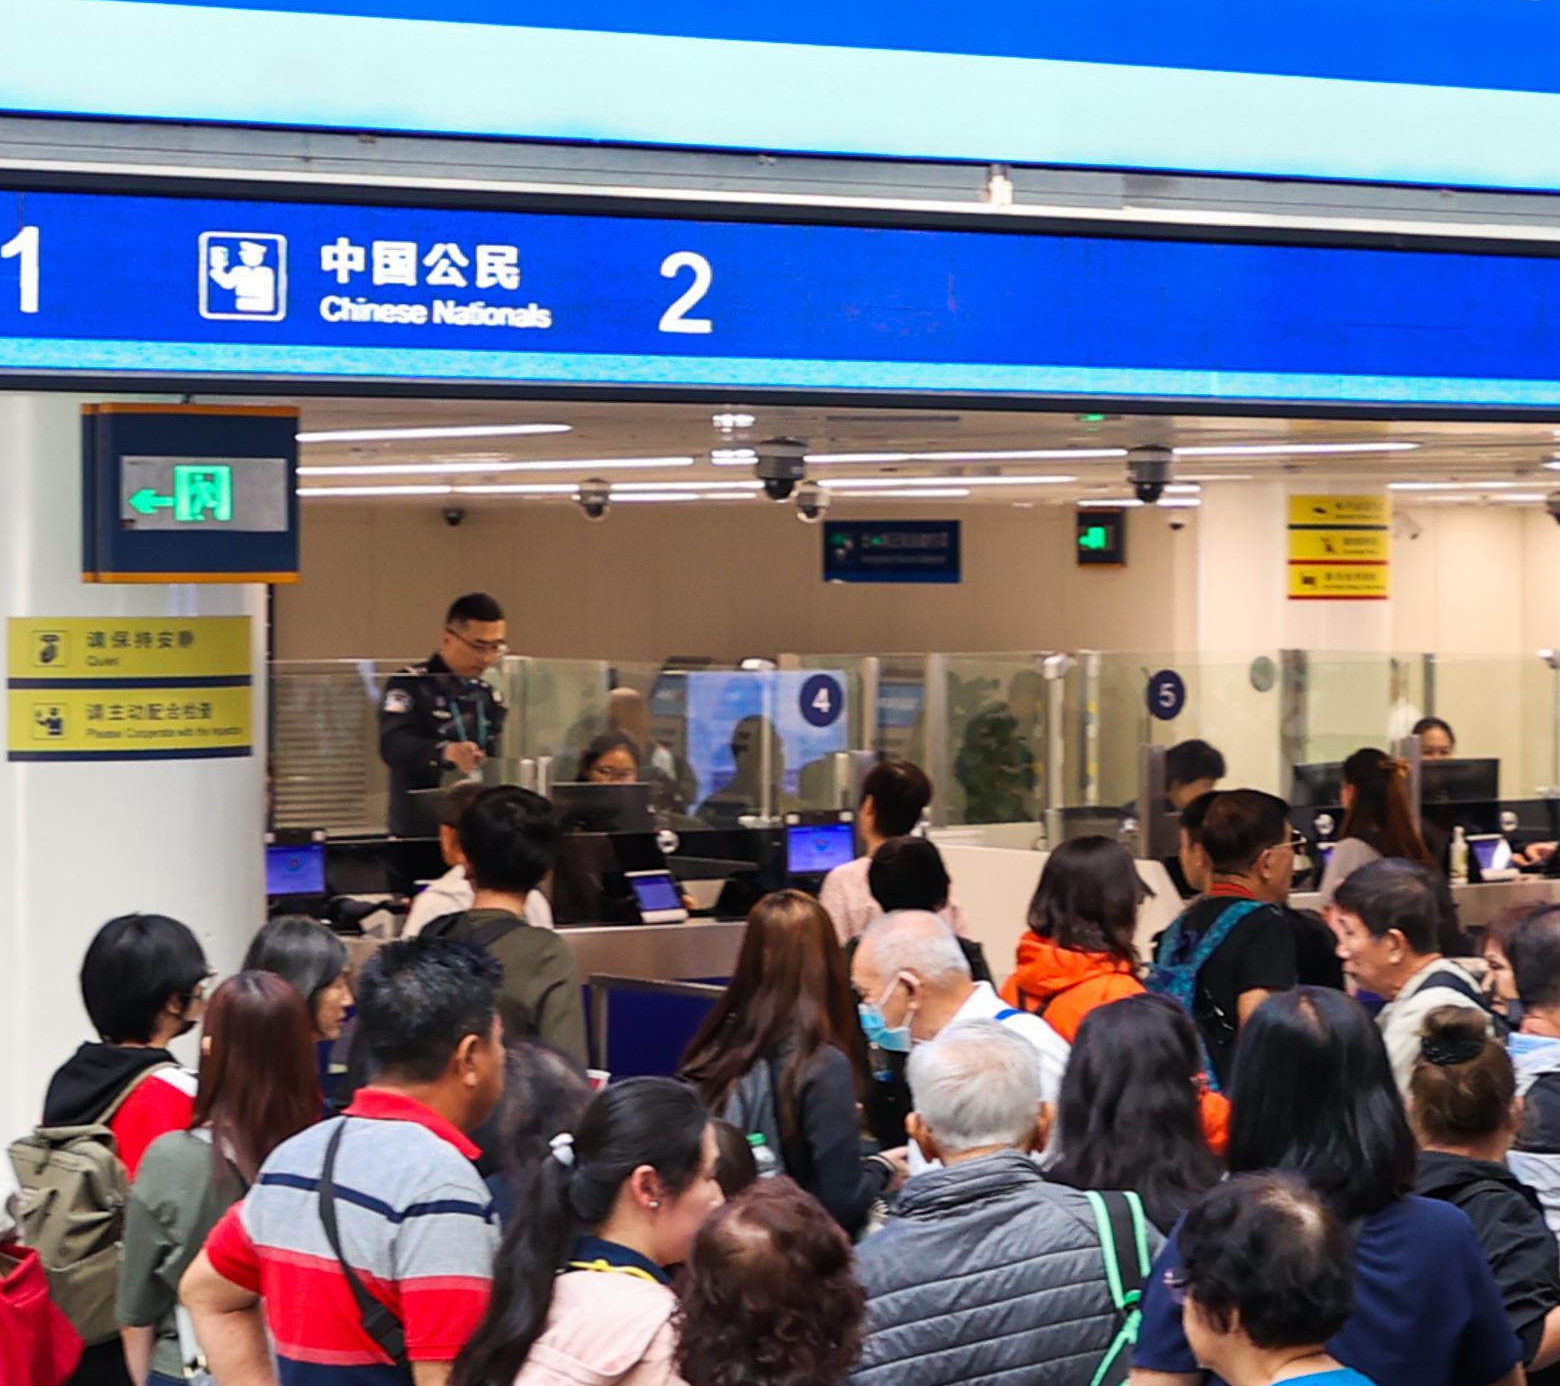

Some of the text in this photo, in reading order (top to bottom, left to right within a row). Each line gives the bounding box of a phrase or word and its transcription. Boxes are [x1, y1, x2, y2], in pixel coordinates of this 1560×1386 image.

[0, 224, 40, 314] 1
[320, 237, 521, 291] 中国公民
[319, 294, 552, 330] Chinese Nationals
[657, 251, 714, 334] 2
[811, 687, 832, 713] 4
[1157, 682, 1177, 708] 5
